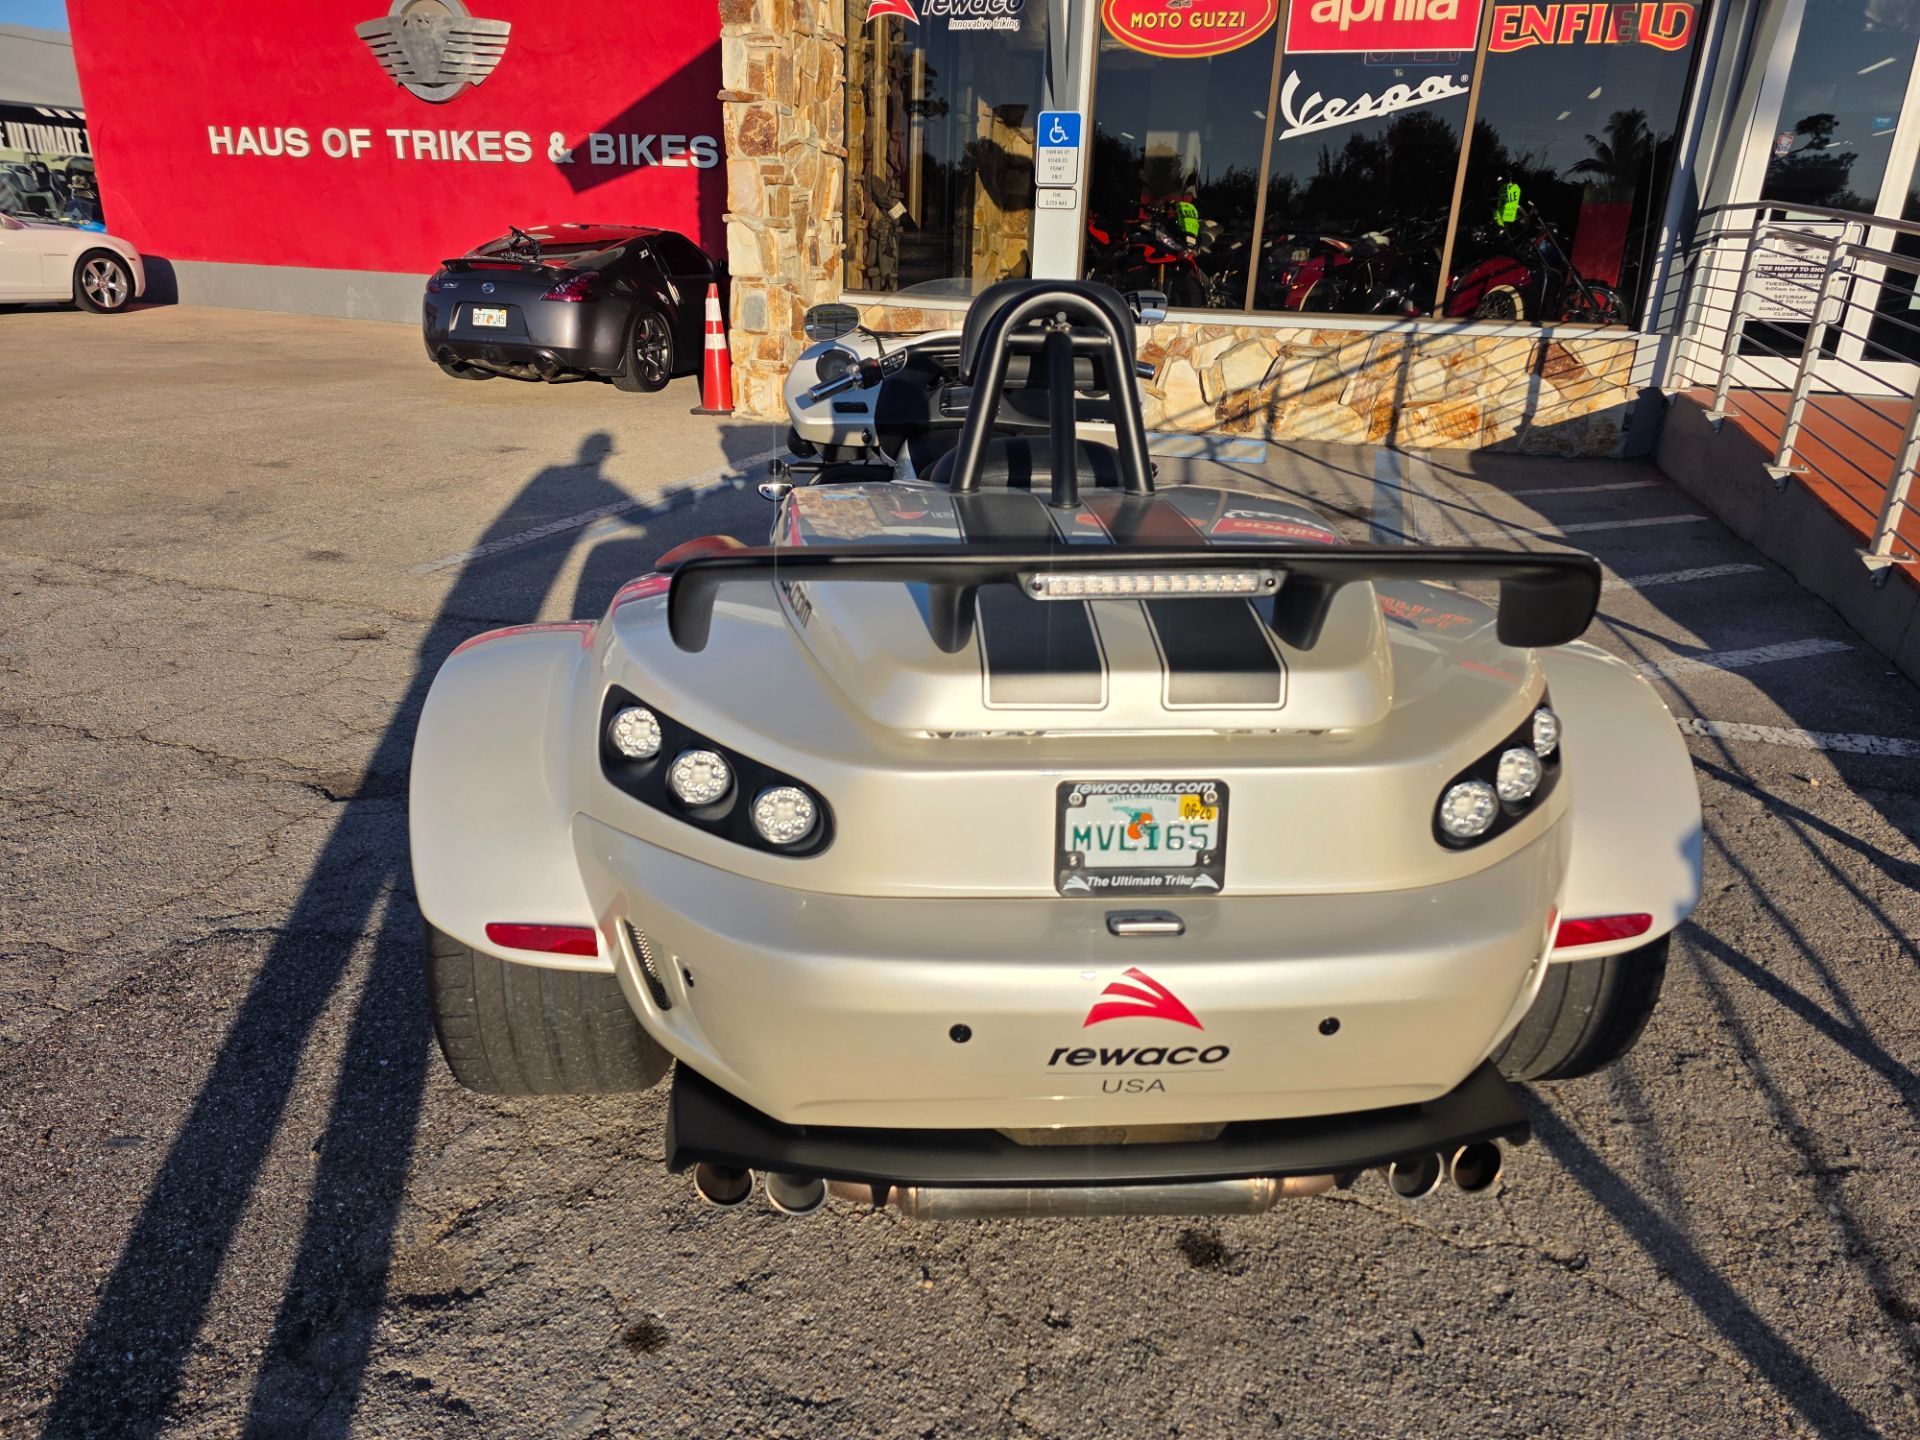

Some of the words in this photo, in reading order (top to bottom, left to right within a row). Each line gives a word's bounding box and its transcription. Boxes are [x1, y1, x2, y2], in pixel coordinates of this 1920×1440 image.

[949, 17, 992, 30] Innovative
[993, 17, 1020, 31] triking
[1131, 12, 1182, 28] MOTO
[1190, 12, 1246, 28] GUZZI
[1487, 2, 1696, 52] ENFIELD
[1279, 69, 1470, 141] Vespa
[4, 121, 84, 156] ULTIMATE
[208, 126, 310, 157] HAUS
[322, 128, 372, 159] OF
[386, 129, 533, 163] TRIKES
[548, 131, 575, 164] &
[588, 132, 719, 169] BIKES
[1073, 781, 1215, 795] rewacousa.com
[1086, 876, 1109, 887] The
[1111, 875, 1162, 887] Ultimate
[1165, 874, 1194, 886] Trike
[1048, 1045, 1230, 1067] rewaco
[1102, 1078, 1166, 1094] USA
